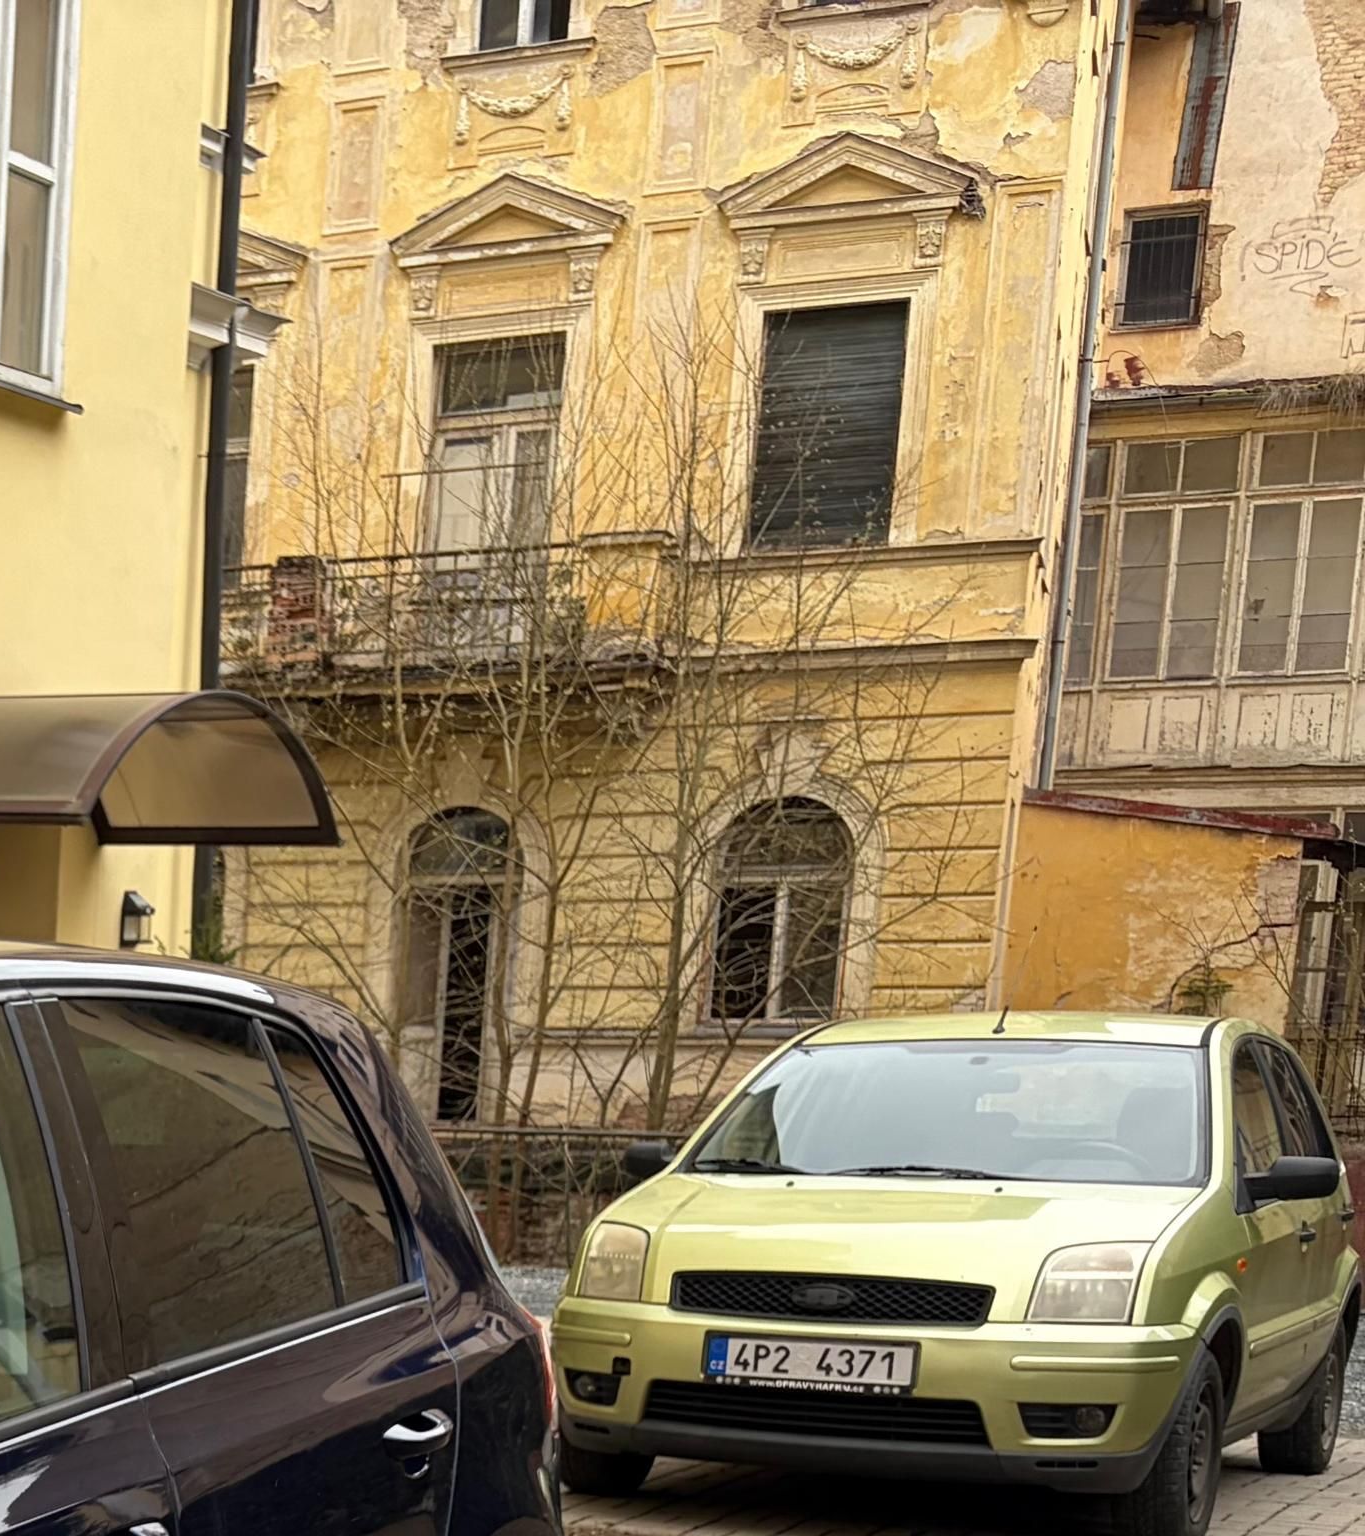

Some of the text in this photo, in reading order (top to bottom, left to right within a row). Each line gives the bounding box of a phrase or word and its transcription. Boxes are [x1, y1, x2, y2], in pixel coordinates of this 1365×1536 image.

[709, 1343, 896, 1380] CZ 4P2 4371
